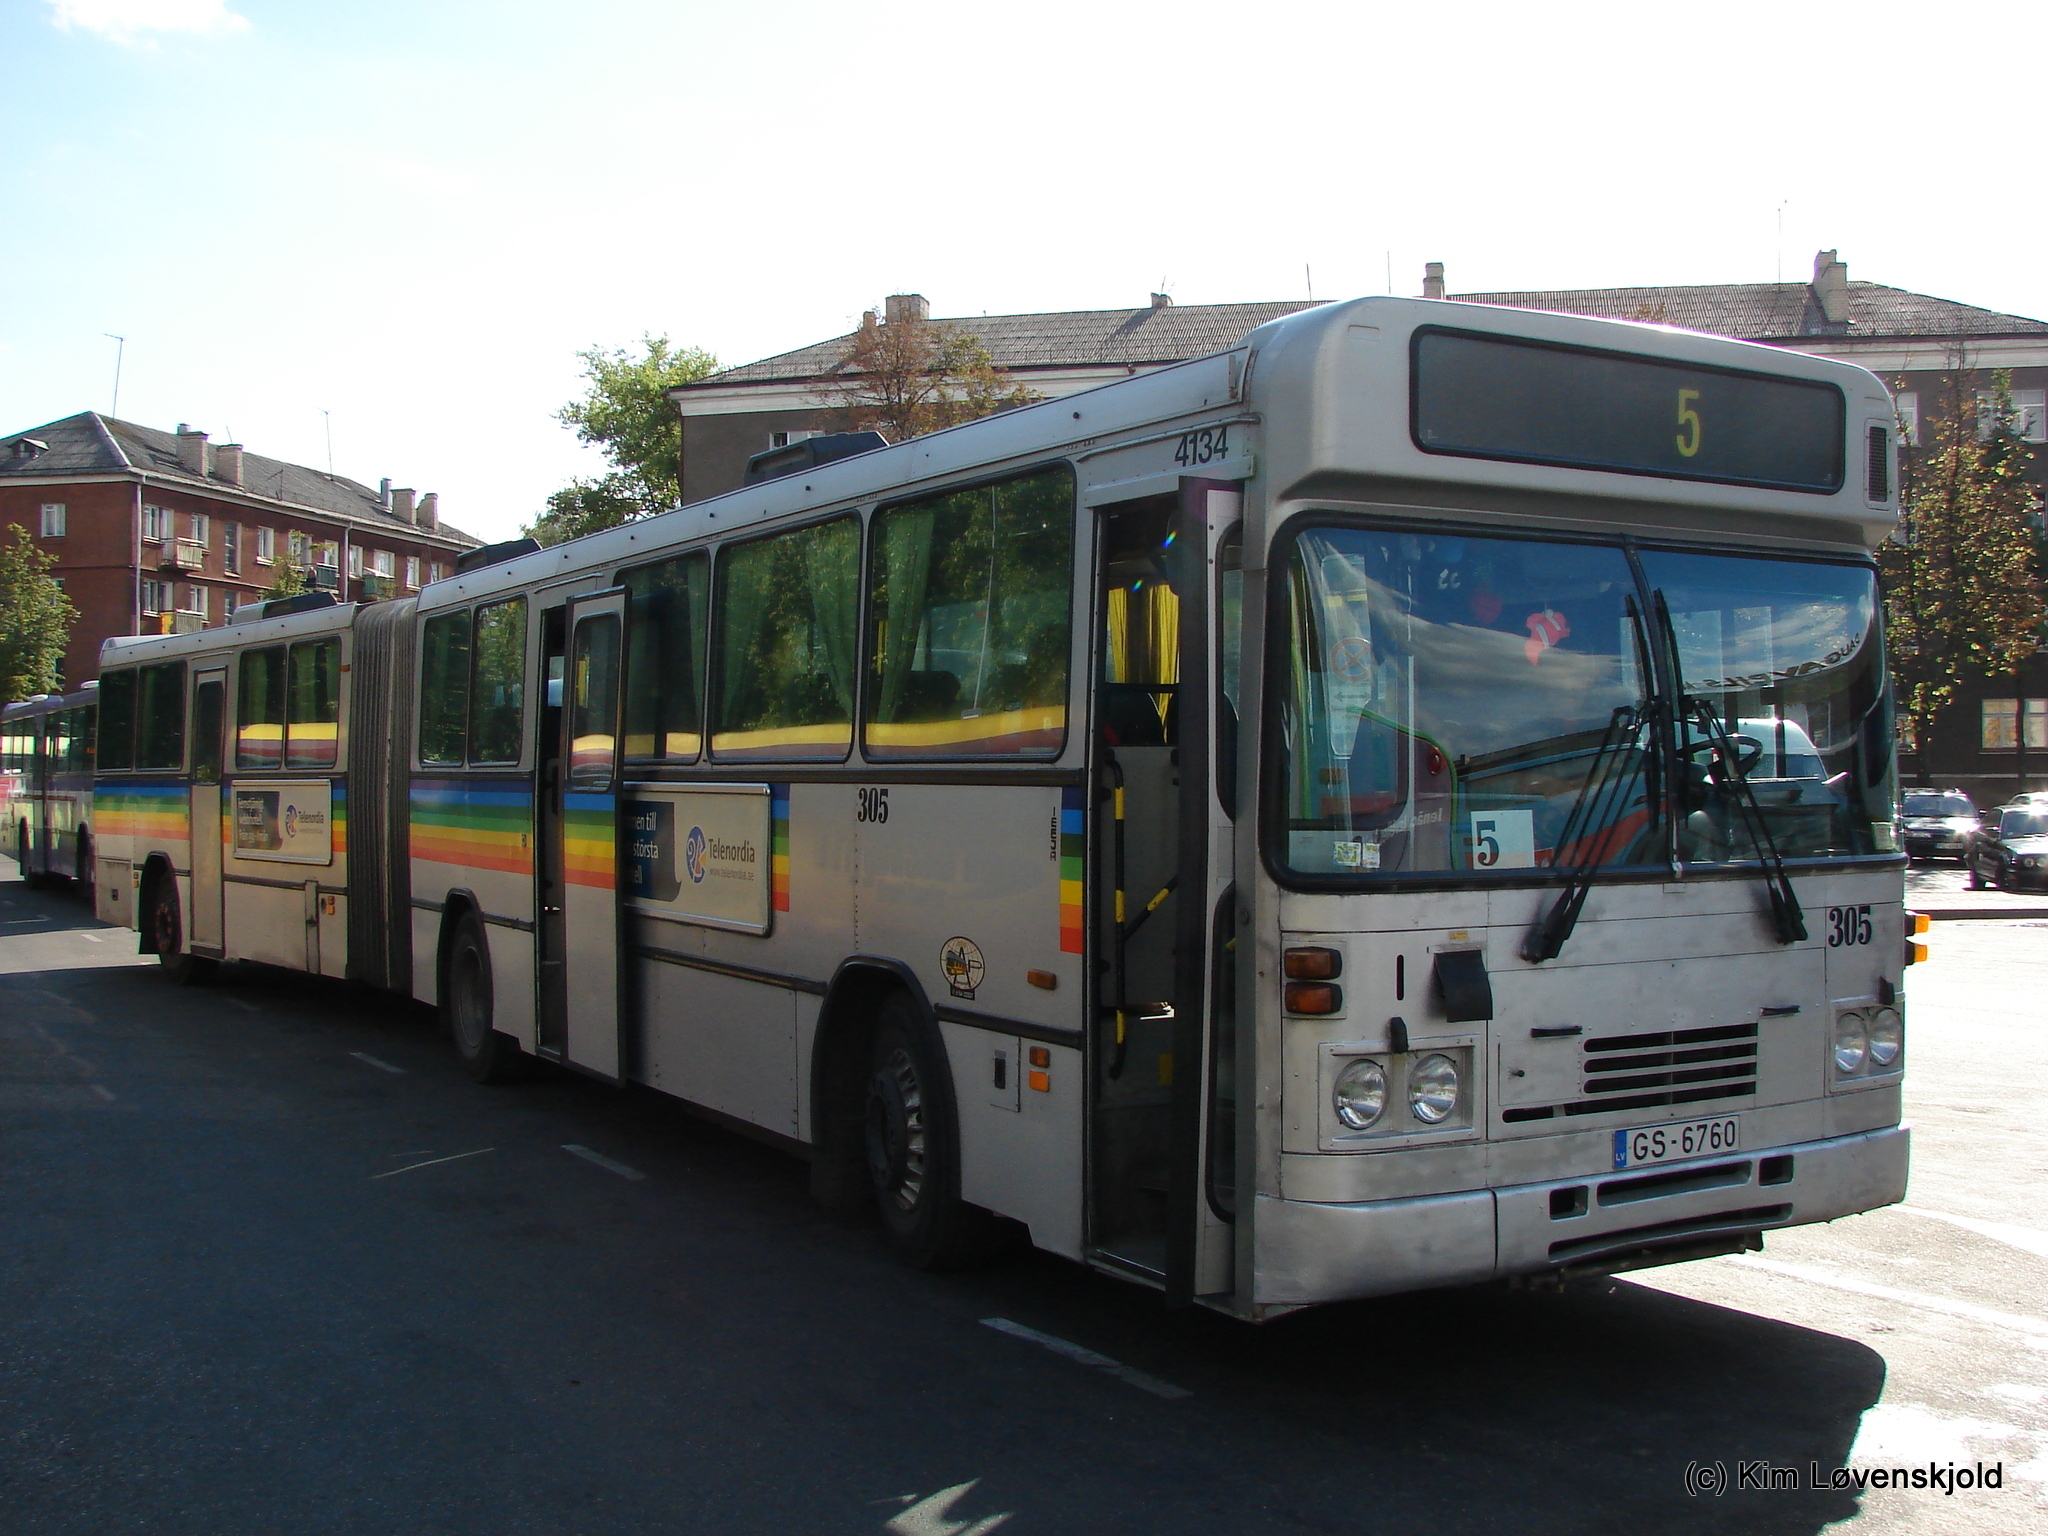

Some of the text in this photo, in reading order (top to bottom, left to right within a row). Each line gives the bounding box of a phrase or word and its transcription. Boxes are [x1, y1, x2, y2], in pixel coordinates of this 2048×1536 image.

[1675, 388, 1701, 458] 5
[1174, 426, 1229, 467] 4134
[857, 787, 889, 824] 305
[633, 838, 659, 859] största
[708, 838, 755, 863] Telenordia
[1476, 820, 1499, 867] 5
[1828, 905, 1872, 948] 305
[1615, 1120, 1736, 1162] LV GS-6760
